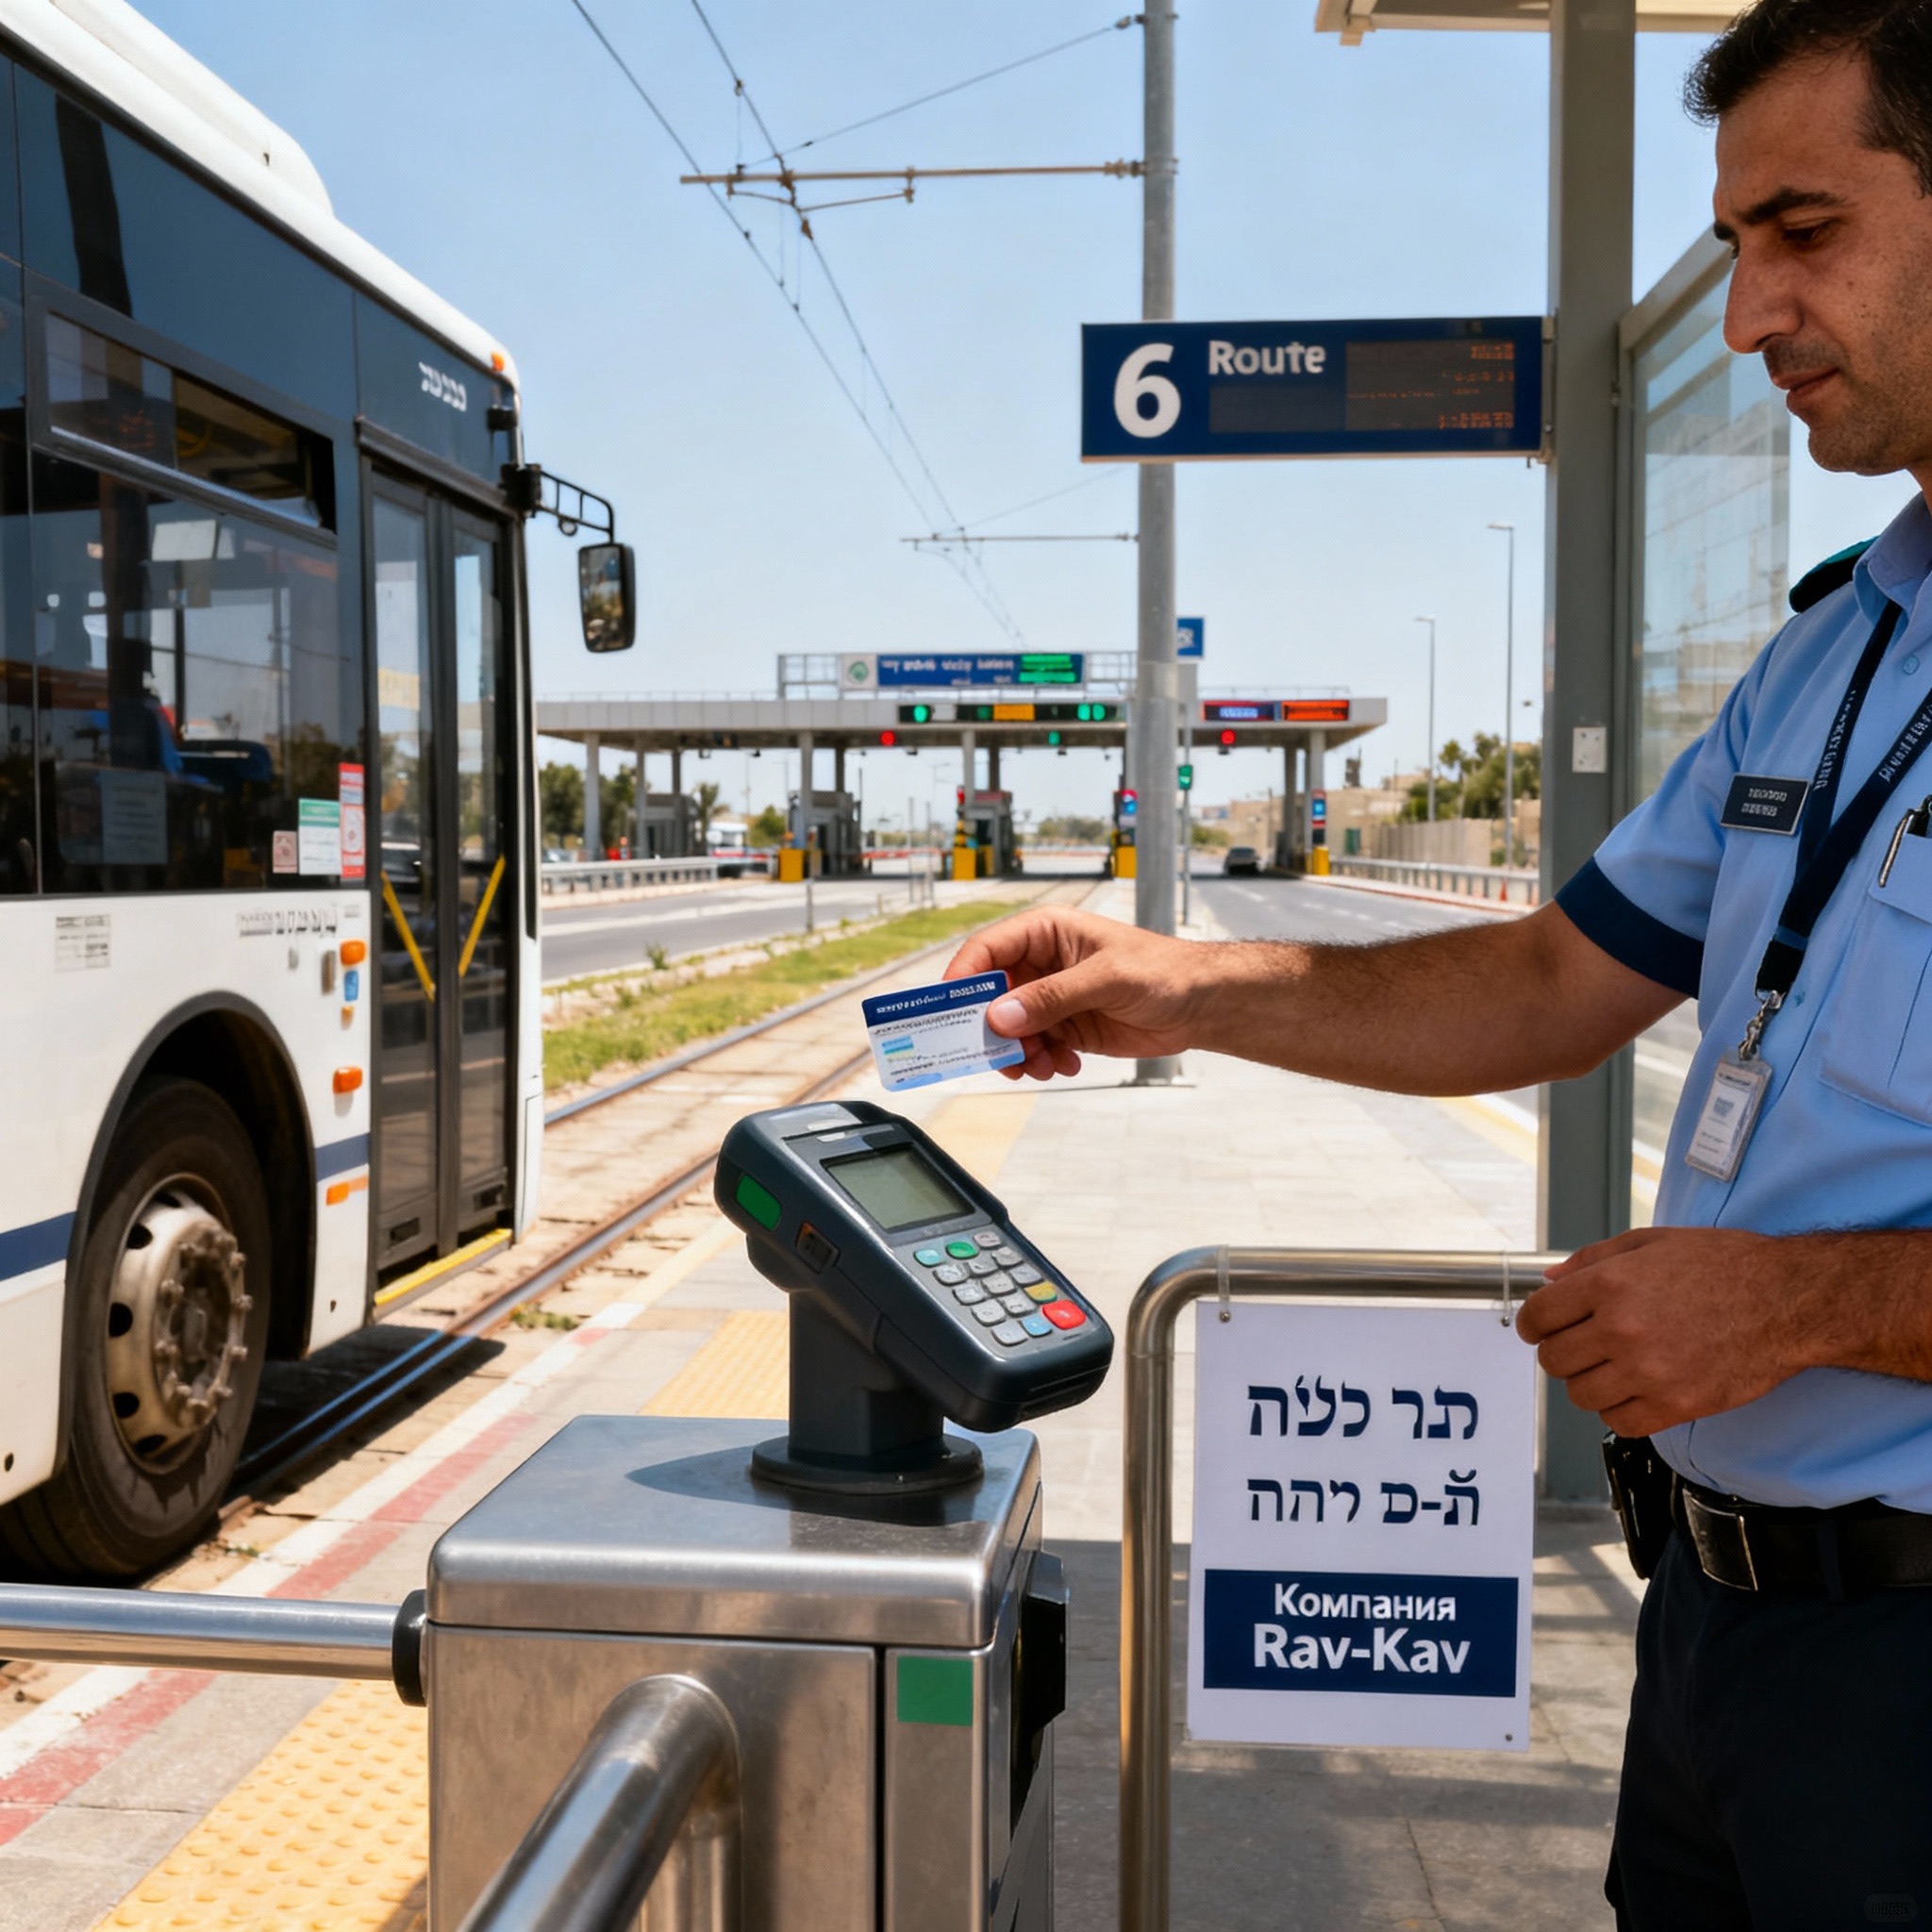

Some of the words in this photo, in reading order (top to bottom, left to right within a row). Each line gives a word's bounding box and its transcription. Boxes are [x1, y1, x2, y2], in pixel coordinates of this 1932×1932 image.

[1114, 342, 1181, 439] 6
[1208, 340, 1326, 375] Route
[1274, 1583, 1456, 1622] Компания
[1254, 1623, 1471, 1674] Rav-Kav
